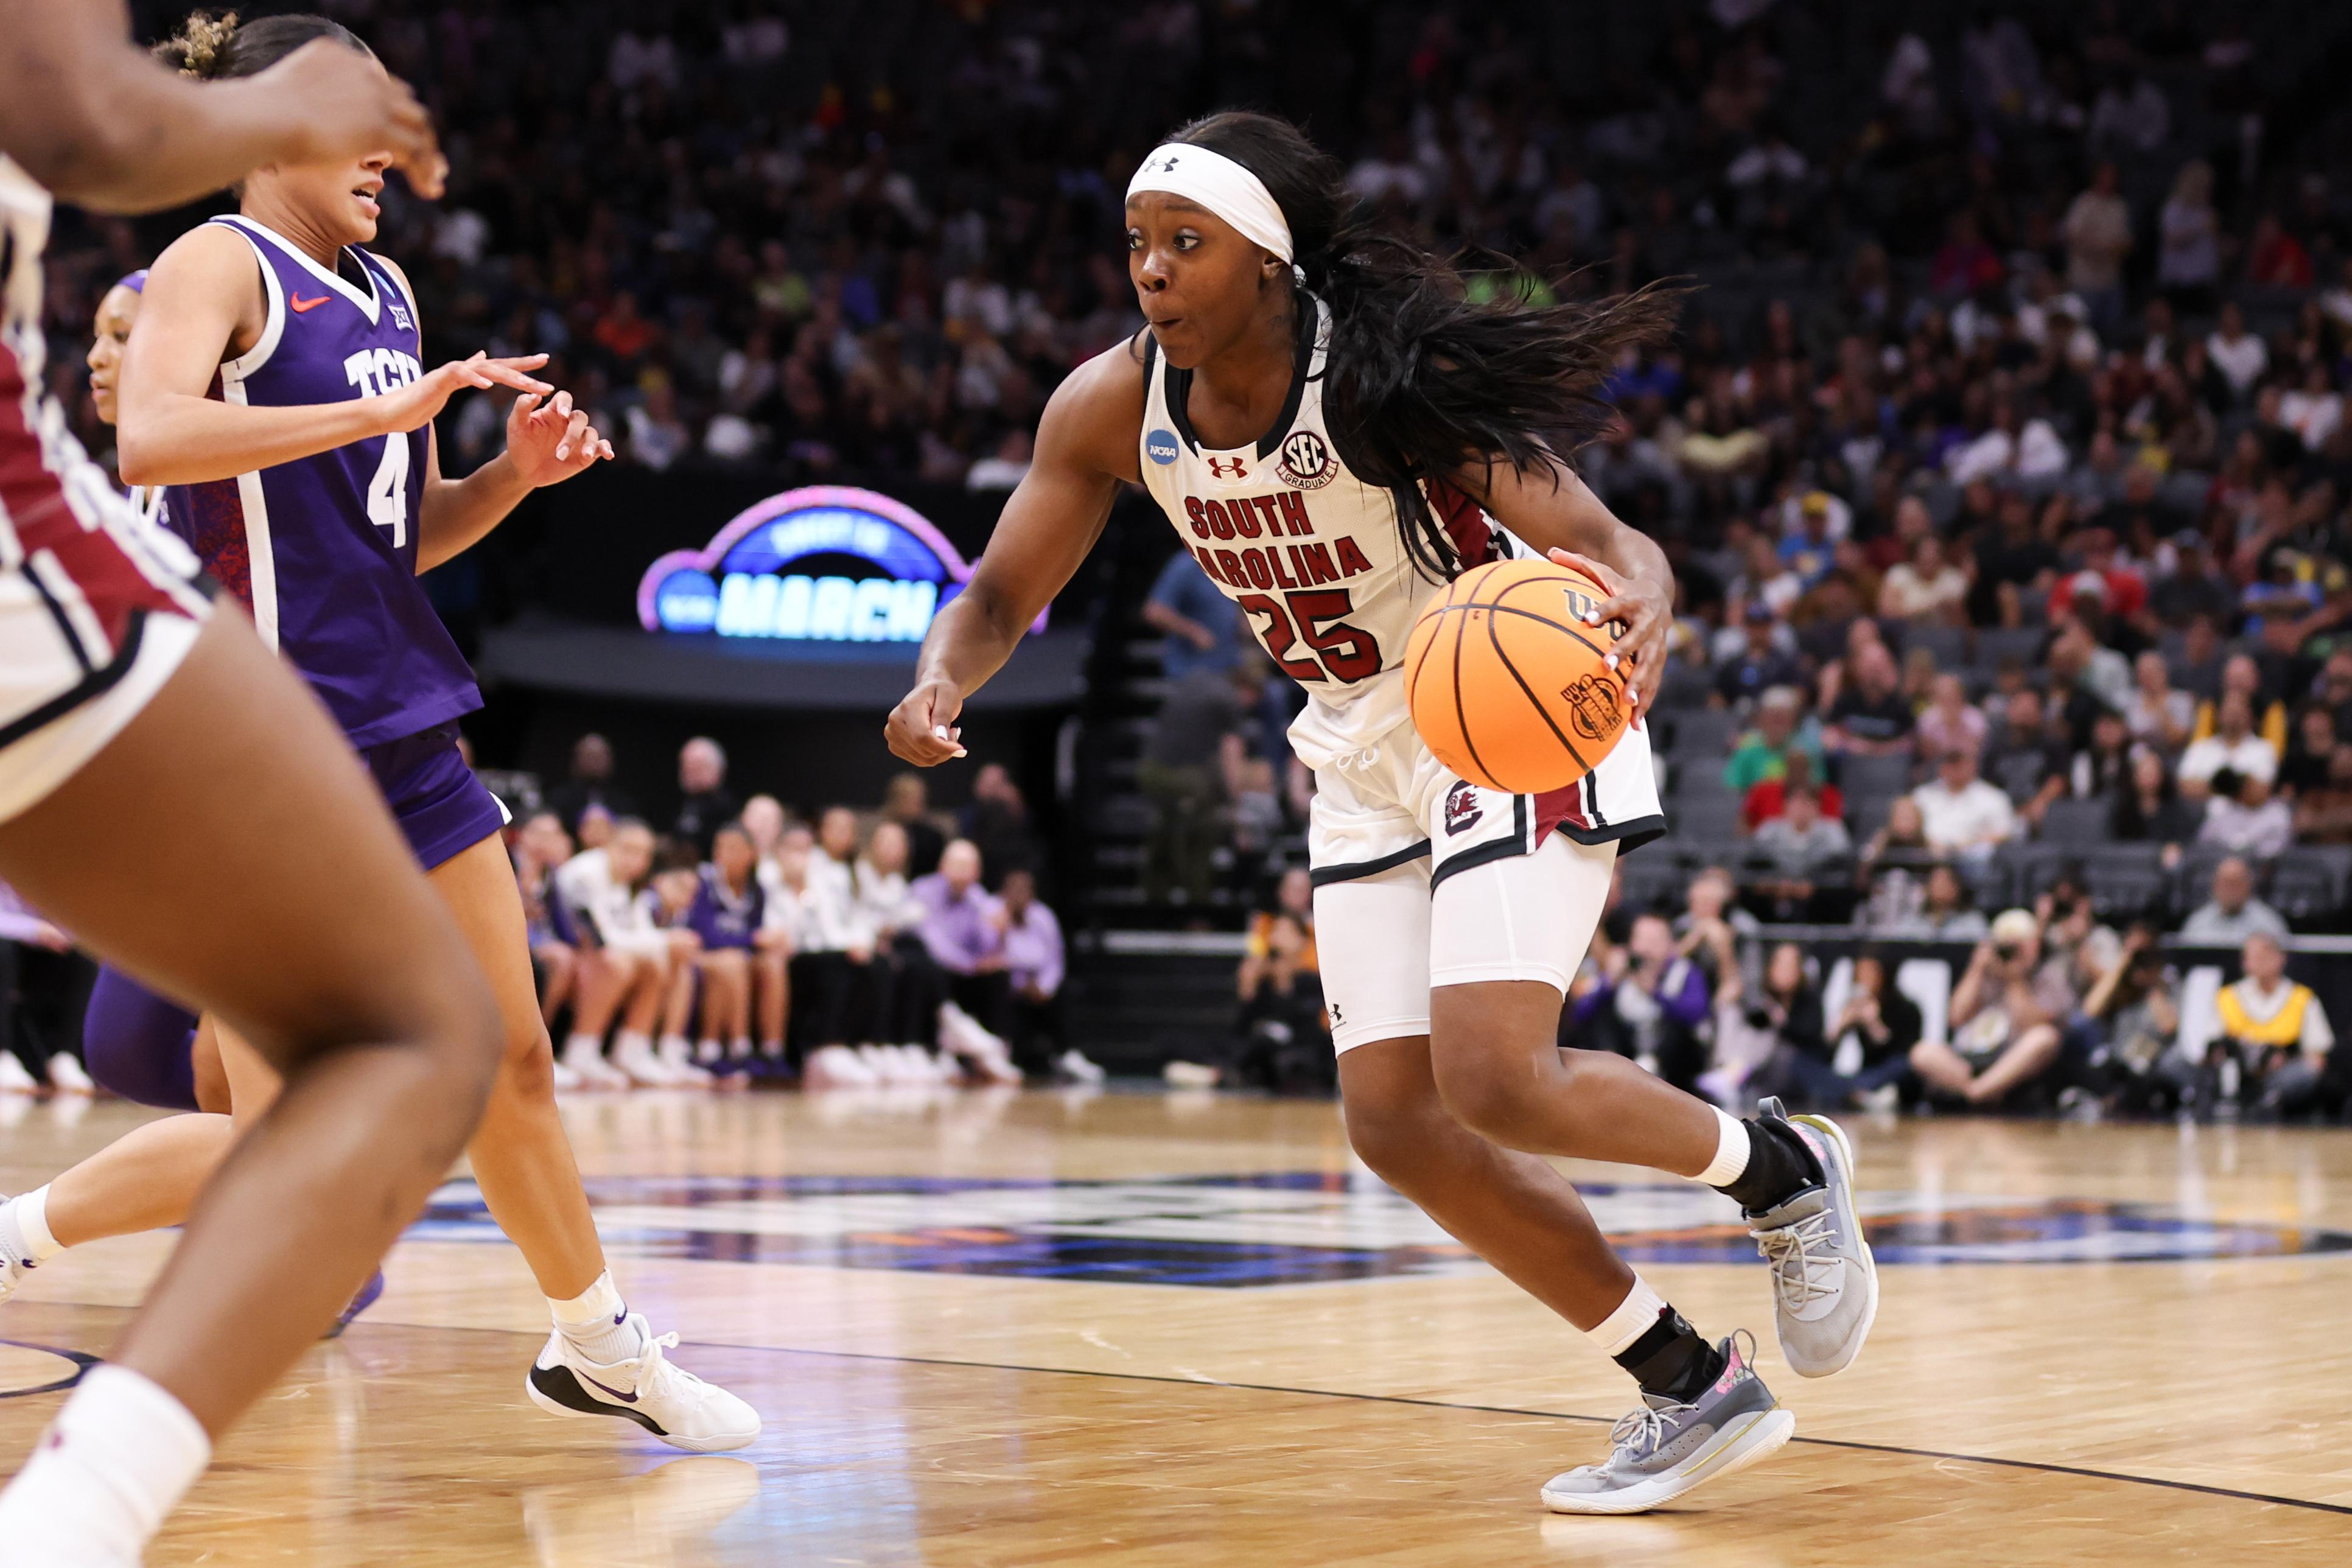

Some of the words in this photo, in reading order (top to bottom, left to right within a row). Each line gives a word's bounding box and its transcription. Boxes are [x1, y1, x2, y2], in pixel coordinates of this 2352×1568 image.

[1149, 445, 1176, 458] NCAA
[1285, 434, 1324, 475] SEC
[366, 432, 410, 548] 4
[1285, 470, 1333, 489] GRADUATE
[1184, 491, 1315, 541] SOUTH
[1182, 536, 1374, 590] AROLINA
[715, 572, 938, 642] MARCH
[1236, 588, 1384, 684] 25
